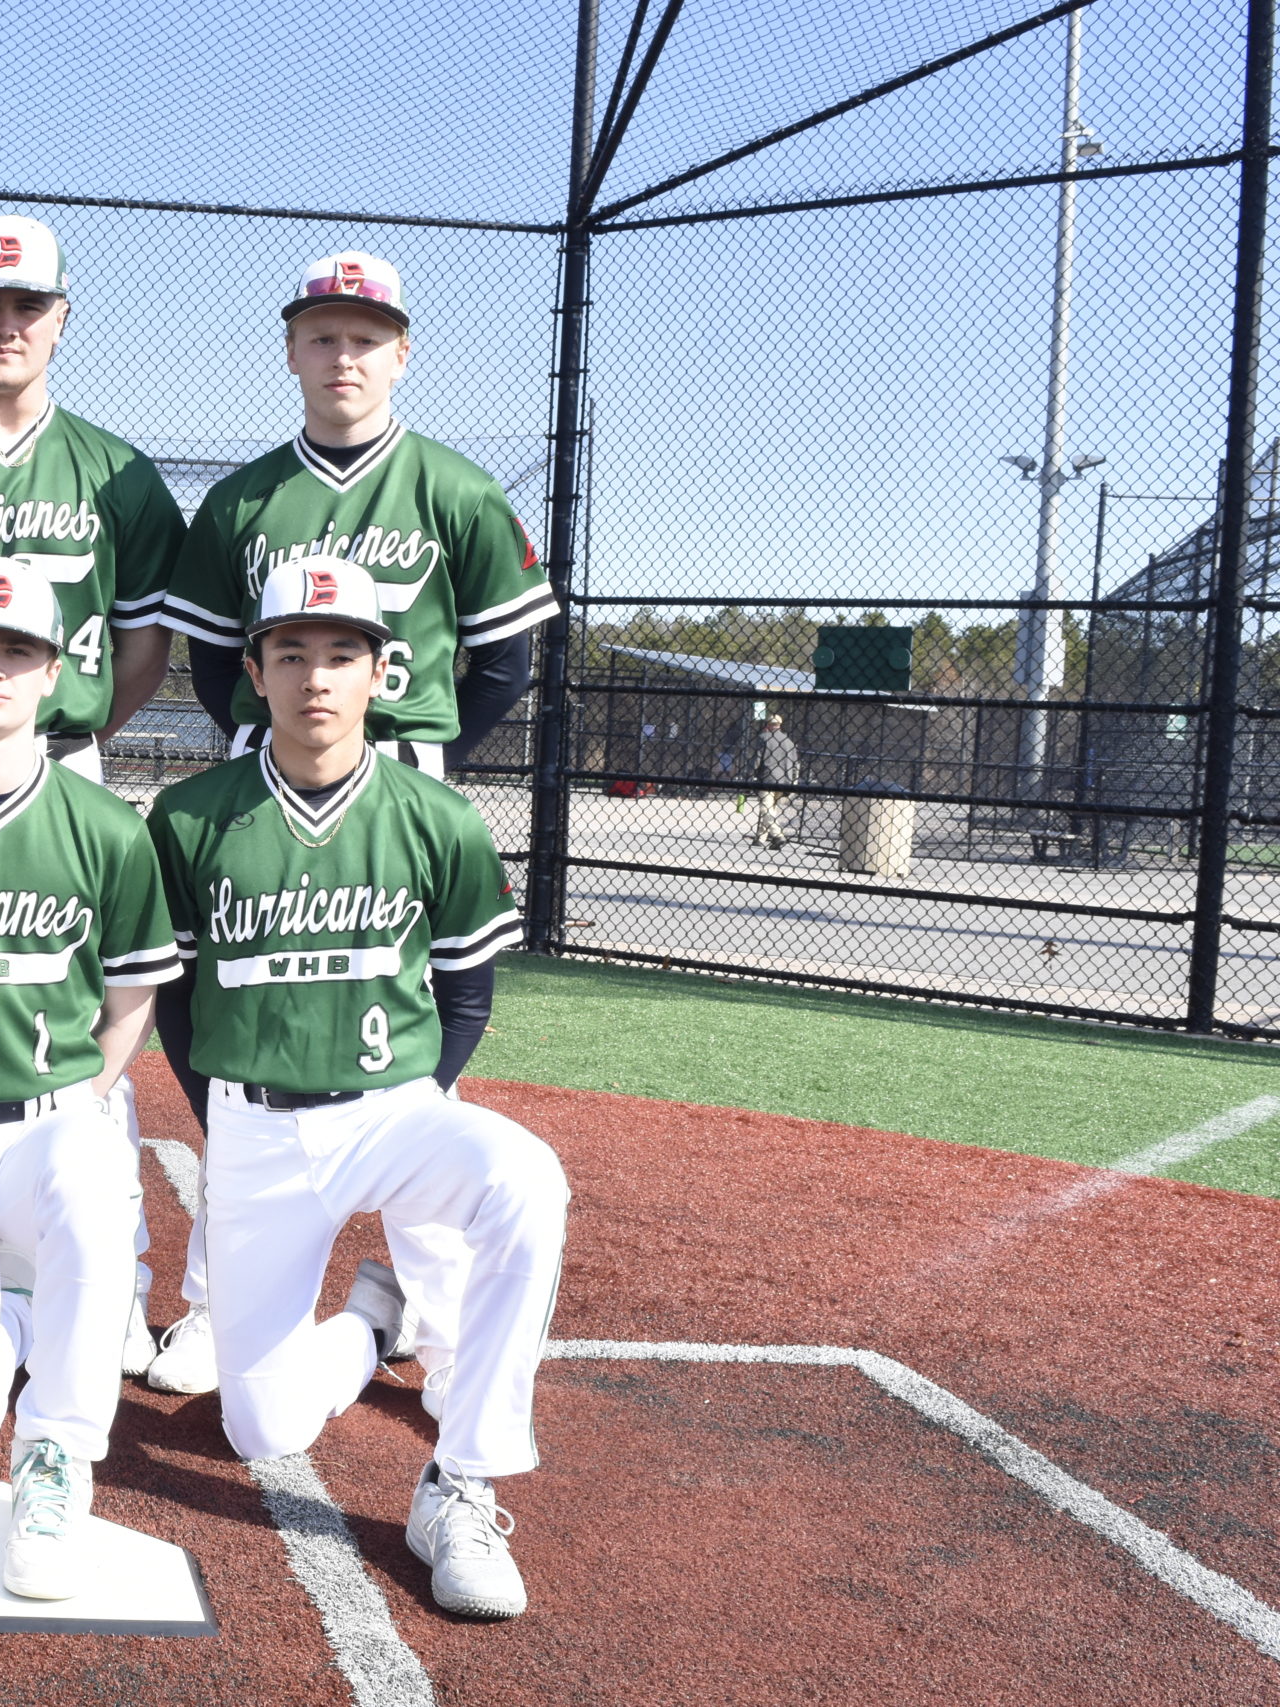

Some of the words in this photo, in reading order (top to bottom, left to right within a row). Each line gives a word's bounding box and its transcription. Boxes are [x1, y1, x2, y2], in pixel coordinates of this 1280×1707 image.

[68, 613, 106, 678] 4
[380, 639, 414, 703] 6
[209, 872, 423, 944] Hurricanes
[268, 955, 350, 977] WHB
[33, 1009, 54, 1076] 1
[357, 1002, 395, 1074] 9
